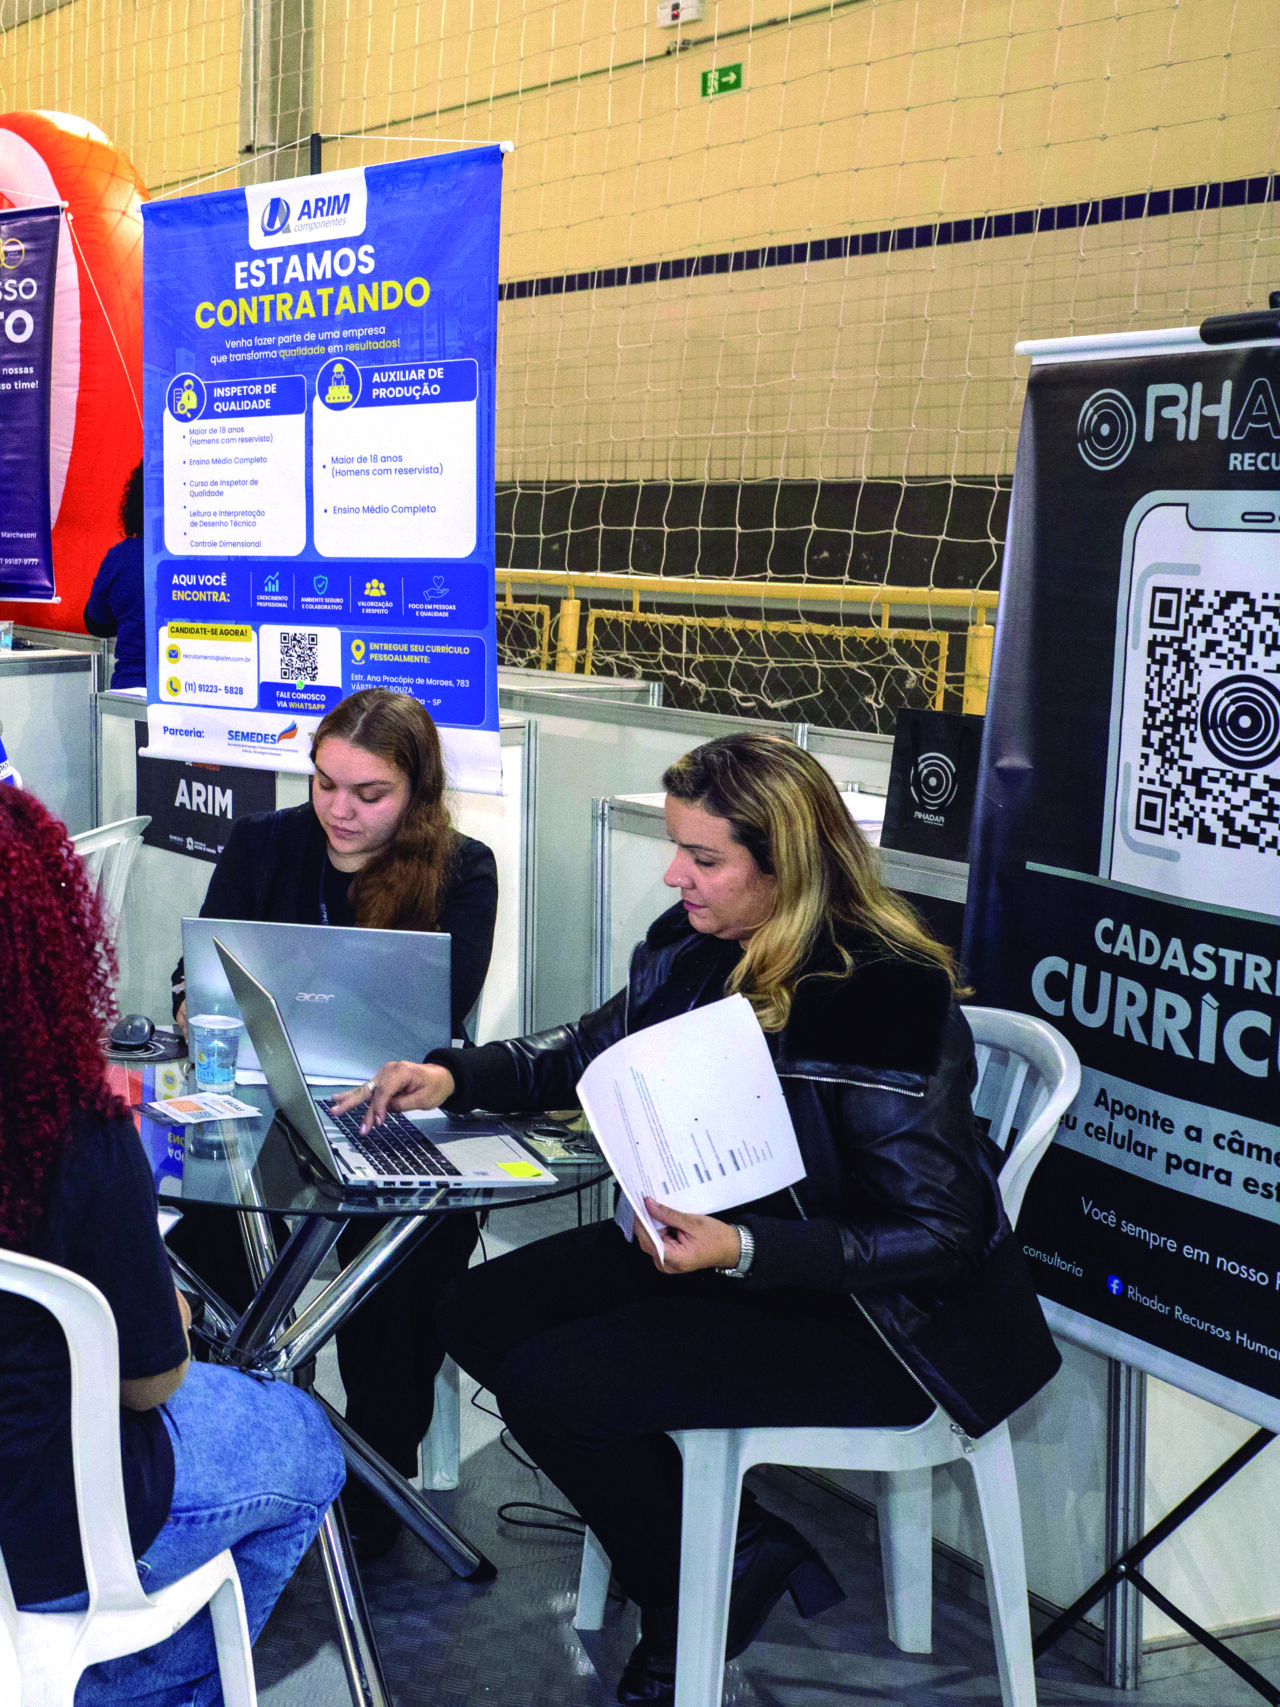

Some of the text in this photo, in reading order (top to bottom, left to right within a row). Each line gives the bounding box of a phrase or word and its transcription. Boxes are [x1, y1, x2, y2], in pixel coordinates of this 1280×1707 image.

[297, 193, 351, 221] ARIM
[294, 217, 347, 232] componentes
[234, 244, 375, 290] ESTAMOS
[195, 277, 431, 329] CONTRATANDO
[225, 325, 386, 349] Venha fazer parte de uma empresa
[210, 338, 400, 365] que transforma qualidade em resultados!
[2, 366, 34, 375] nossas
[372, 368, 444, 383] AUXILIAR DE
[14, 380, 39, 390] time!
[213, 384, 277, 398] INSPETOR DE
[372, 383, 440, 400] PRODUÇÃO
[213, 399, 271, 413] QUALIDADE
[1145, 378, 1280, 442] RHA
[189, 427, 207, 435] Maior
[219, 426, 226, 434] 18
[189, 436, 220, 447] (Homens
[238, 433, 274, 444] reservista)
[211, 457, 233, 465] Médio
[234, 456, 267, 466] Completo
[331, 454, 403, 465] Maior de 18 anos
[1228, 452, 1280, 471] RECU
[331, 463, 444, 478] (Homens com reservista)
[210, 479, 219, 487] de
[219, 479, 248, 488] Inspetor
[189, 489, 224, 498] Qualidade
[189, 510, 212, 518] Leitura
[218, 509, 265, 519] Interpretação
[333, 504, 437, 516] Ensino Médio Completo
[230, 519, 257, 527] Técnico
[1, 531, 37, 539] Marchesoni
[190, 540, 262, 548] Controle Dimensional
[172, 572, 227, 586] AQUI VOCÊ
[172, 590, 230, 602] ENCONTRA:
[358, 601, 393, 609] VALORIZAÇÃO
[170, 626, 248, 637] CANDIDATE-SE AGORA!
[370, 643, 470, 654] ENTREGUE SEU CURRÍCULO
[370, 653, 431, 664] PESSOALMENTE:
[351, 673, 470, 688] Estr. Ana Procópio de Moraes, 783
[184, 681, 197, 693] (11)
[224, 685, 244, 696] 5828
[276, 690, 326, 701] FALE CONOSCO
[276, 700, 326, 711] VIA WHATSAPP
[432, 698, 441, 706] SP
[163, 726, 205, 738] Parceria:
[227, 730, 277, 744] SEMEDES
[174, 778, 232, 820] ARIM
[914, 811, 945, 824] RHADAR
[1094, 917, 1280, 997] CADASTR
[296, 992, 335, 1002] acer
[1031, 956, 1280, 1078] CURRÌC
[1094, 1088, 1175, 1134] Aponte
[1184, 1124, 1203, 1143] a
[1084, 1122, 1157, 1161] celular
[1165, 1152, 1233, 1187] para
[1081, 1196, 1269, 1286] Você sempre em nosso
[1023, 1245, 1083, 1278] consultoria
[1127, 1285, 1280, 1361] Rhadar Recursos Huma
